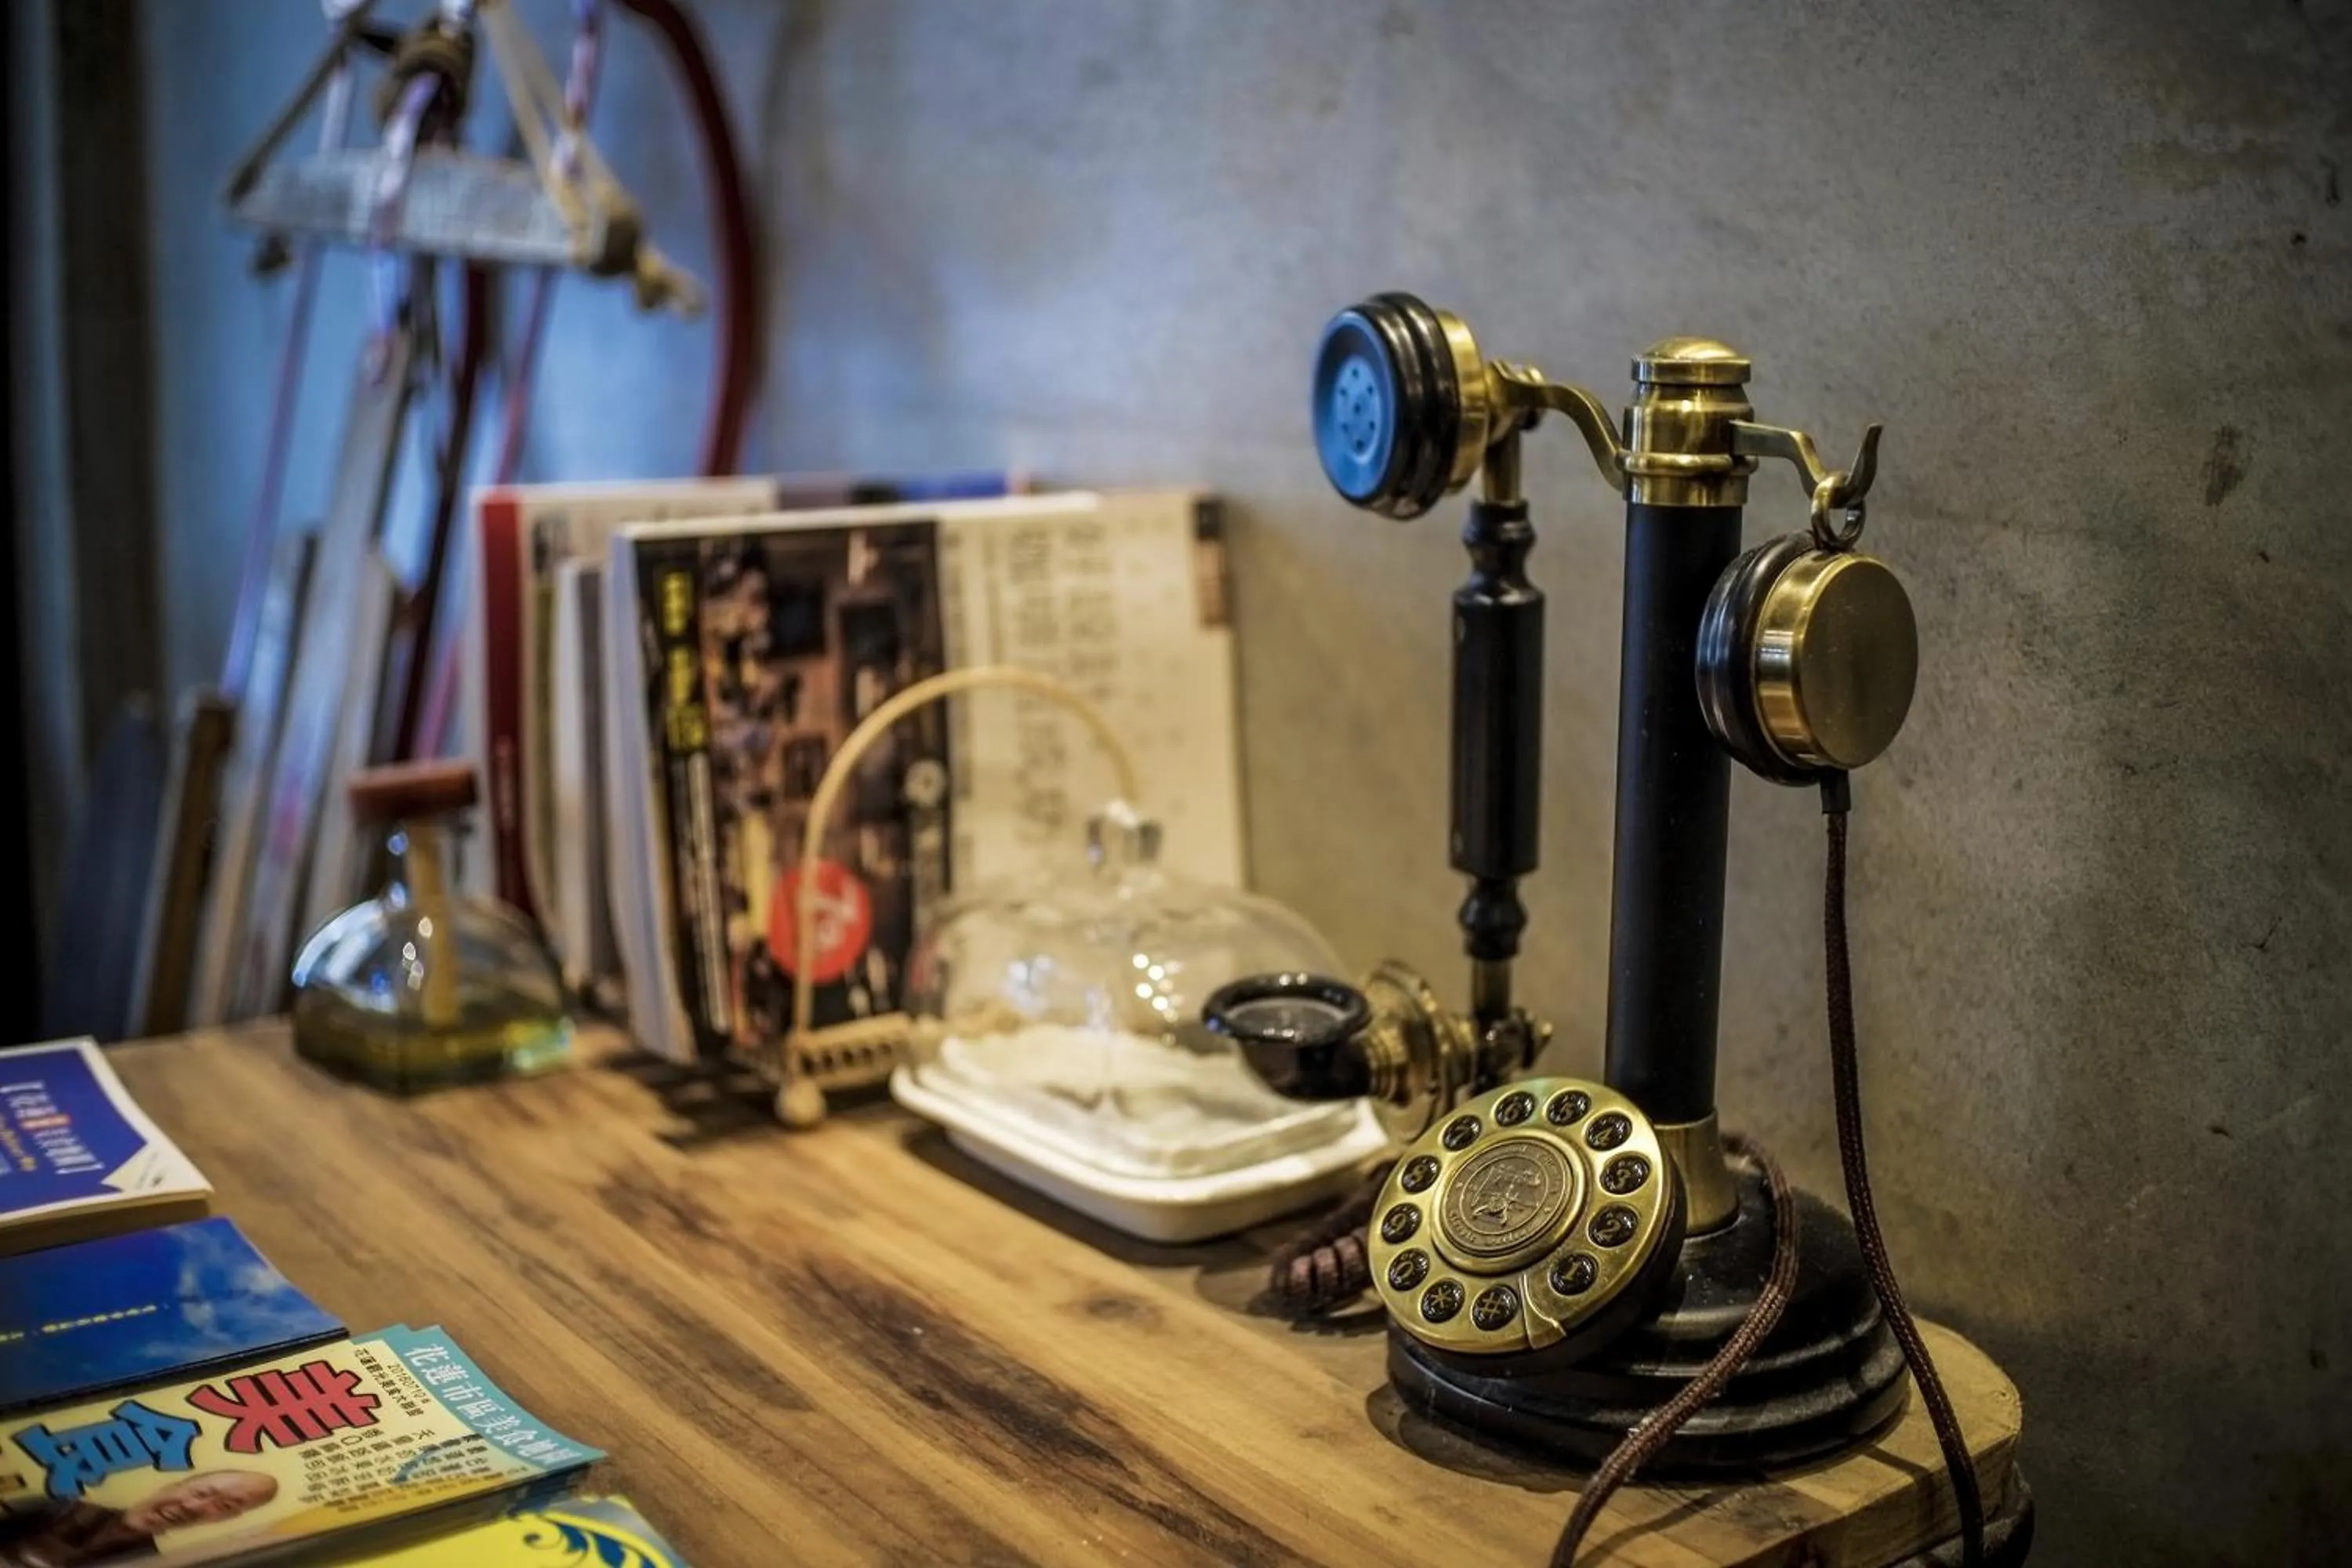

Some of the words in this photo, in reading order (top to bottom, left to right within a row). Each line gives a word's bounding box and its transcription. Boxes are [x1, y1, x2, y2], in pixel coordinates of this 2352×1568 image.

[1559, 1103, 1574, 1121] 5
[1594, 1127, 1613, 1146] 4
[1616, 1167, 1632, 1189] 3
[1391, 1213, 1406, 1232] 9
[1599, 1218, 1621, 1239] 2
[1396, 1260, 1414, 1279] 0
[1563, 1262, 1581, 1281] 1
[0, 1359, 383, 1503] 美食
